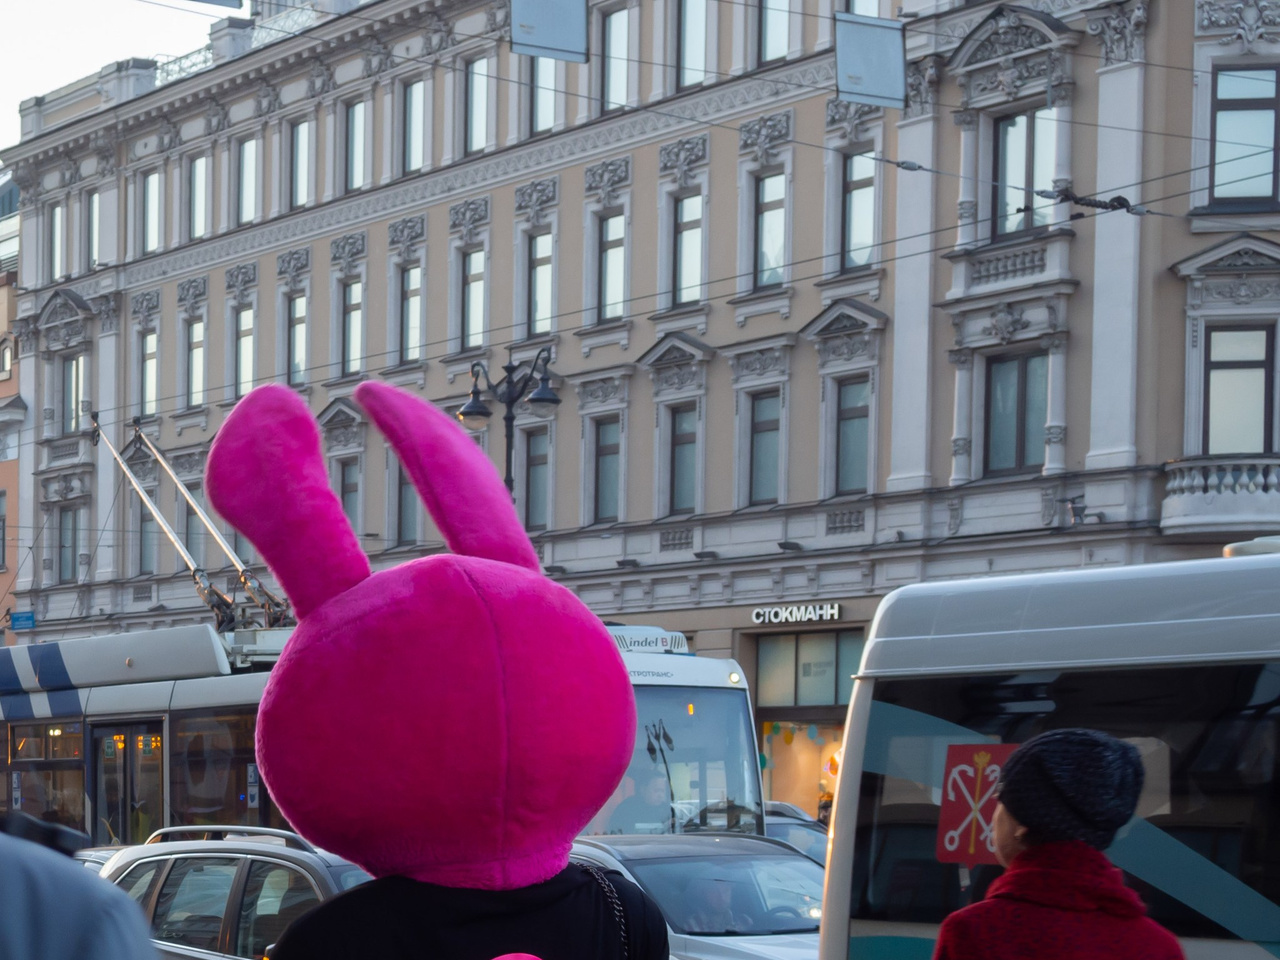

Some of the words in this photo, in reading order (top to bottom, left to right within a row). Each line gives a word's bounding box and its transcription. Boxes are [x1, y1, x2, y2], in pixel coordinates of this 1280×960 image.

[751, 603, 840, 624] СТОКМАНН
[629, 637, 658, 647] indel
[661, 637, 669, 647] B
